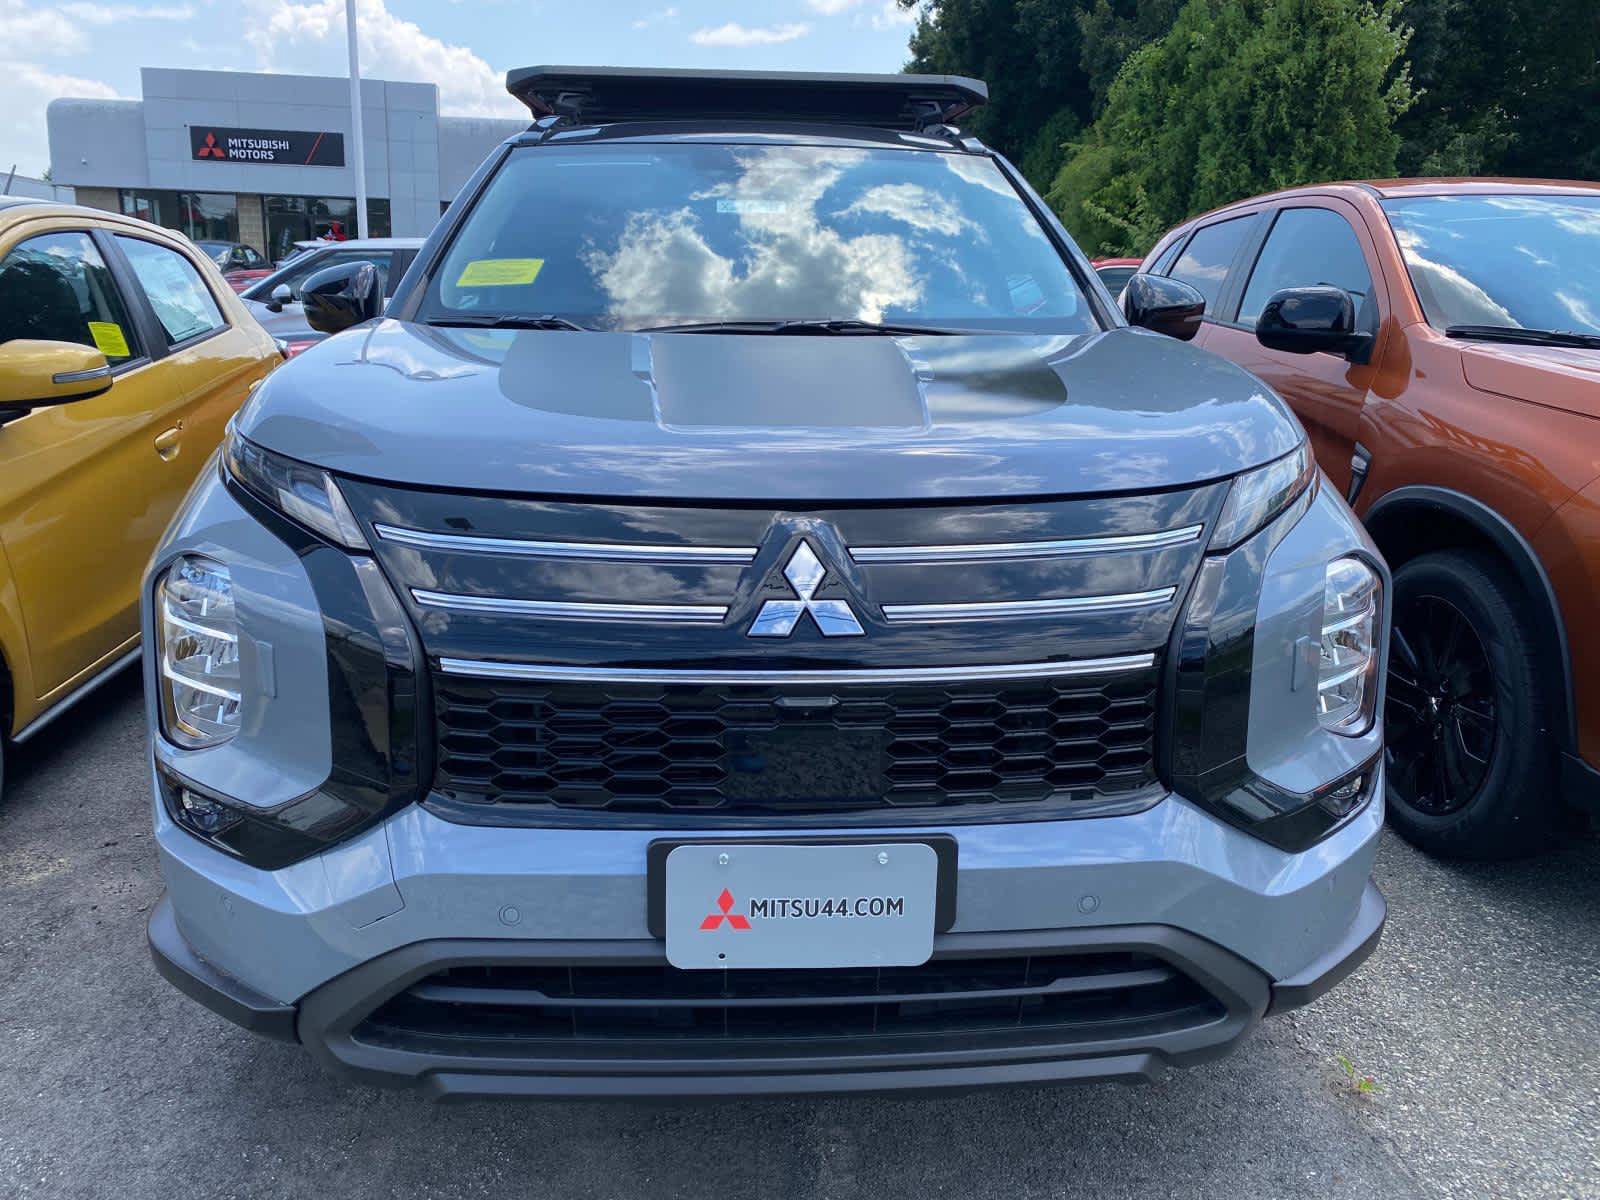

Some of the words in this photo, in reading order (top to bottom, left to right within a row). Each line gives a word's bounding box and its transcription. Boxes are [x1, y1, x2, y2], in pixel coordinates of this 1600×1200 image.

[228, 138, 289, 150] MITSUBISHI
[229, 149, 274, 160] MOTORS
[750, 897, 904, 917] MITSU44.COM
